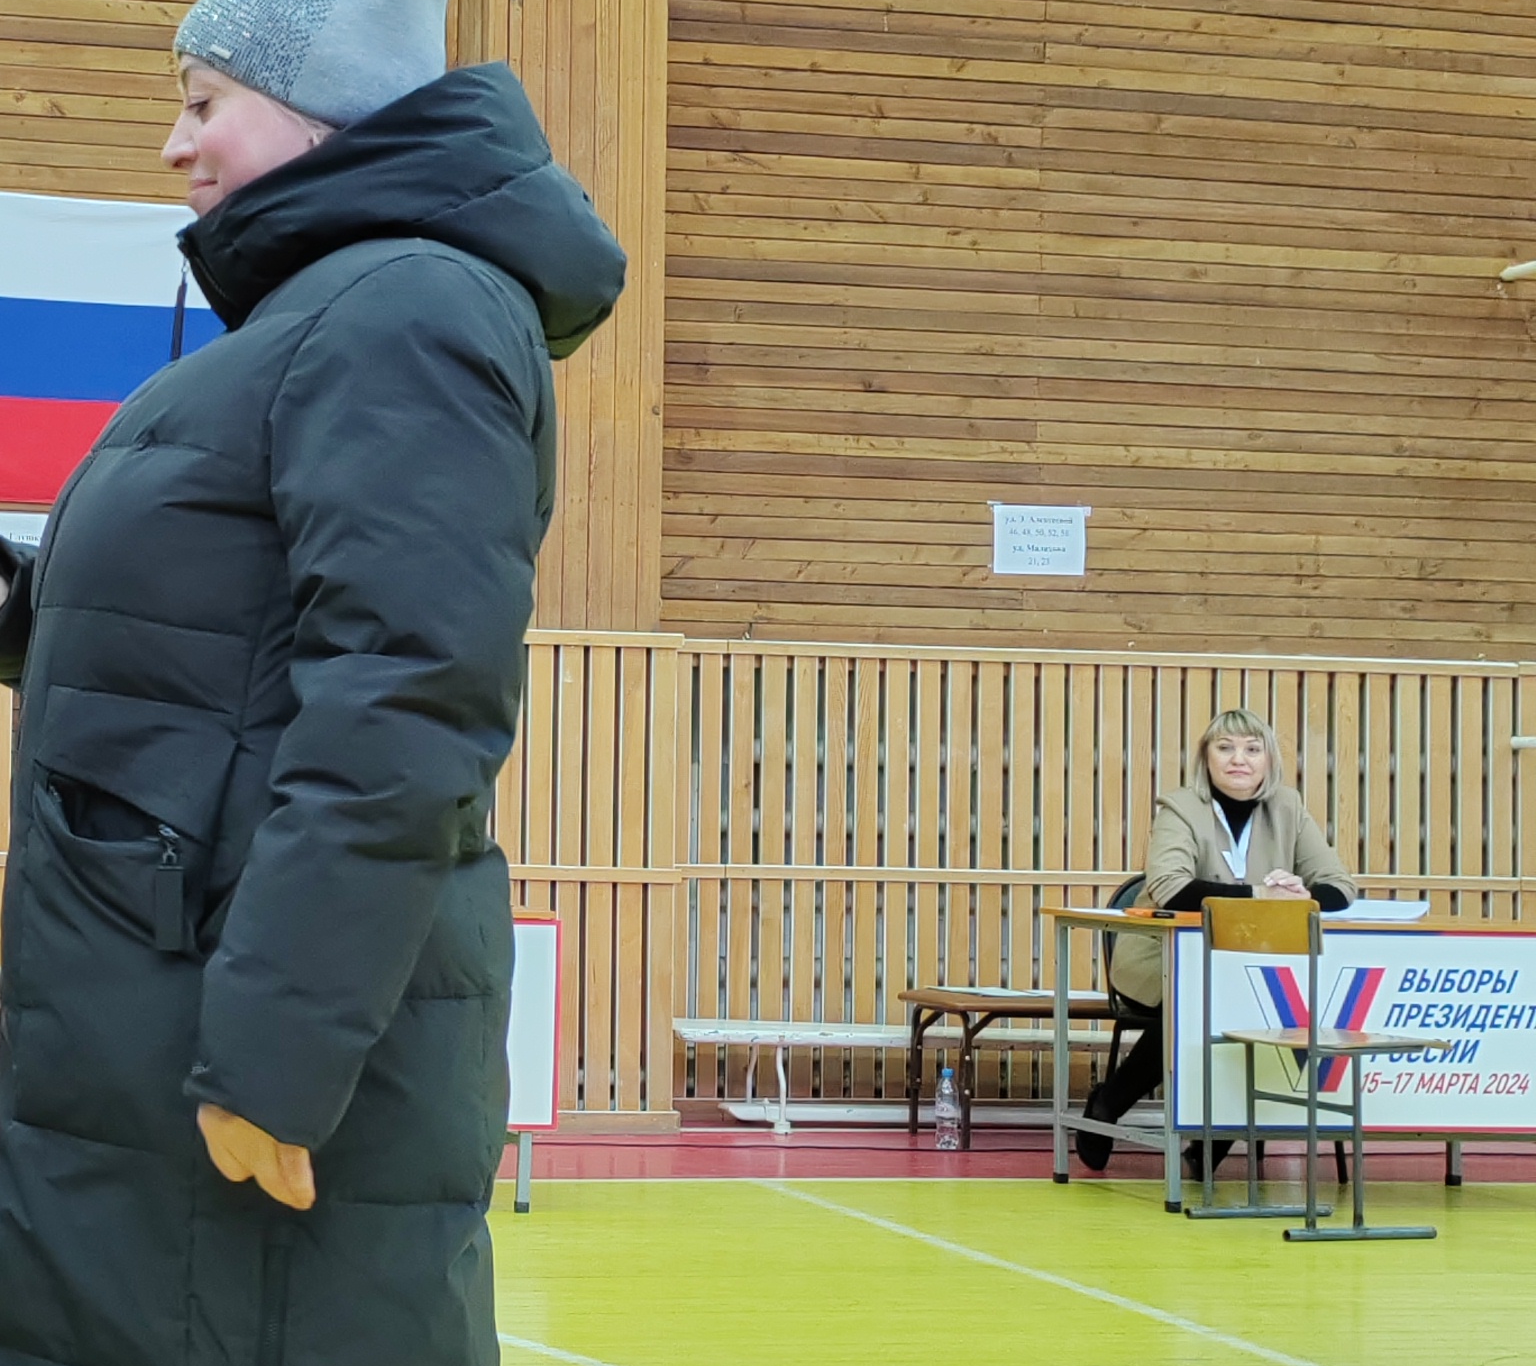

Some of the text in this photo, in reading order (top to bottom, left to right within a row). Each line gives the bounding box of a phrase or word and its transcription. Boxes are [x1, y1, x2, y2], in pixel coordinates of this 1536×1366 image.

[1397, 968, 1519, 994] ВЫБОРЫ
[1383, 1003, 1536, 1033] ПРЕЗИДЕНТ
[1414, 1072, 1479, 1095] МАРТА
[1483, 1073, 1530, 1096] 2024
